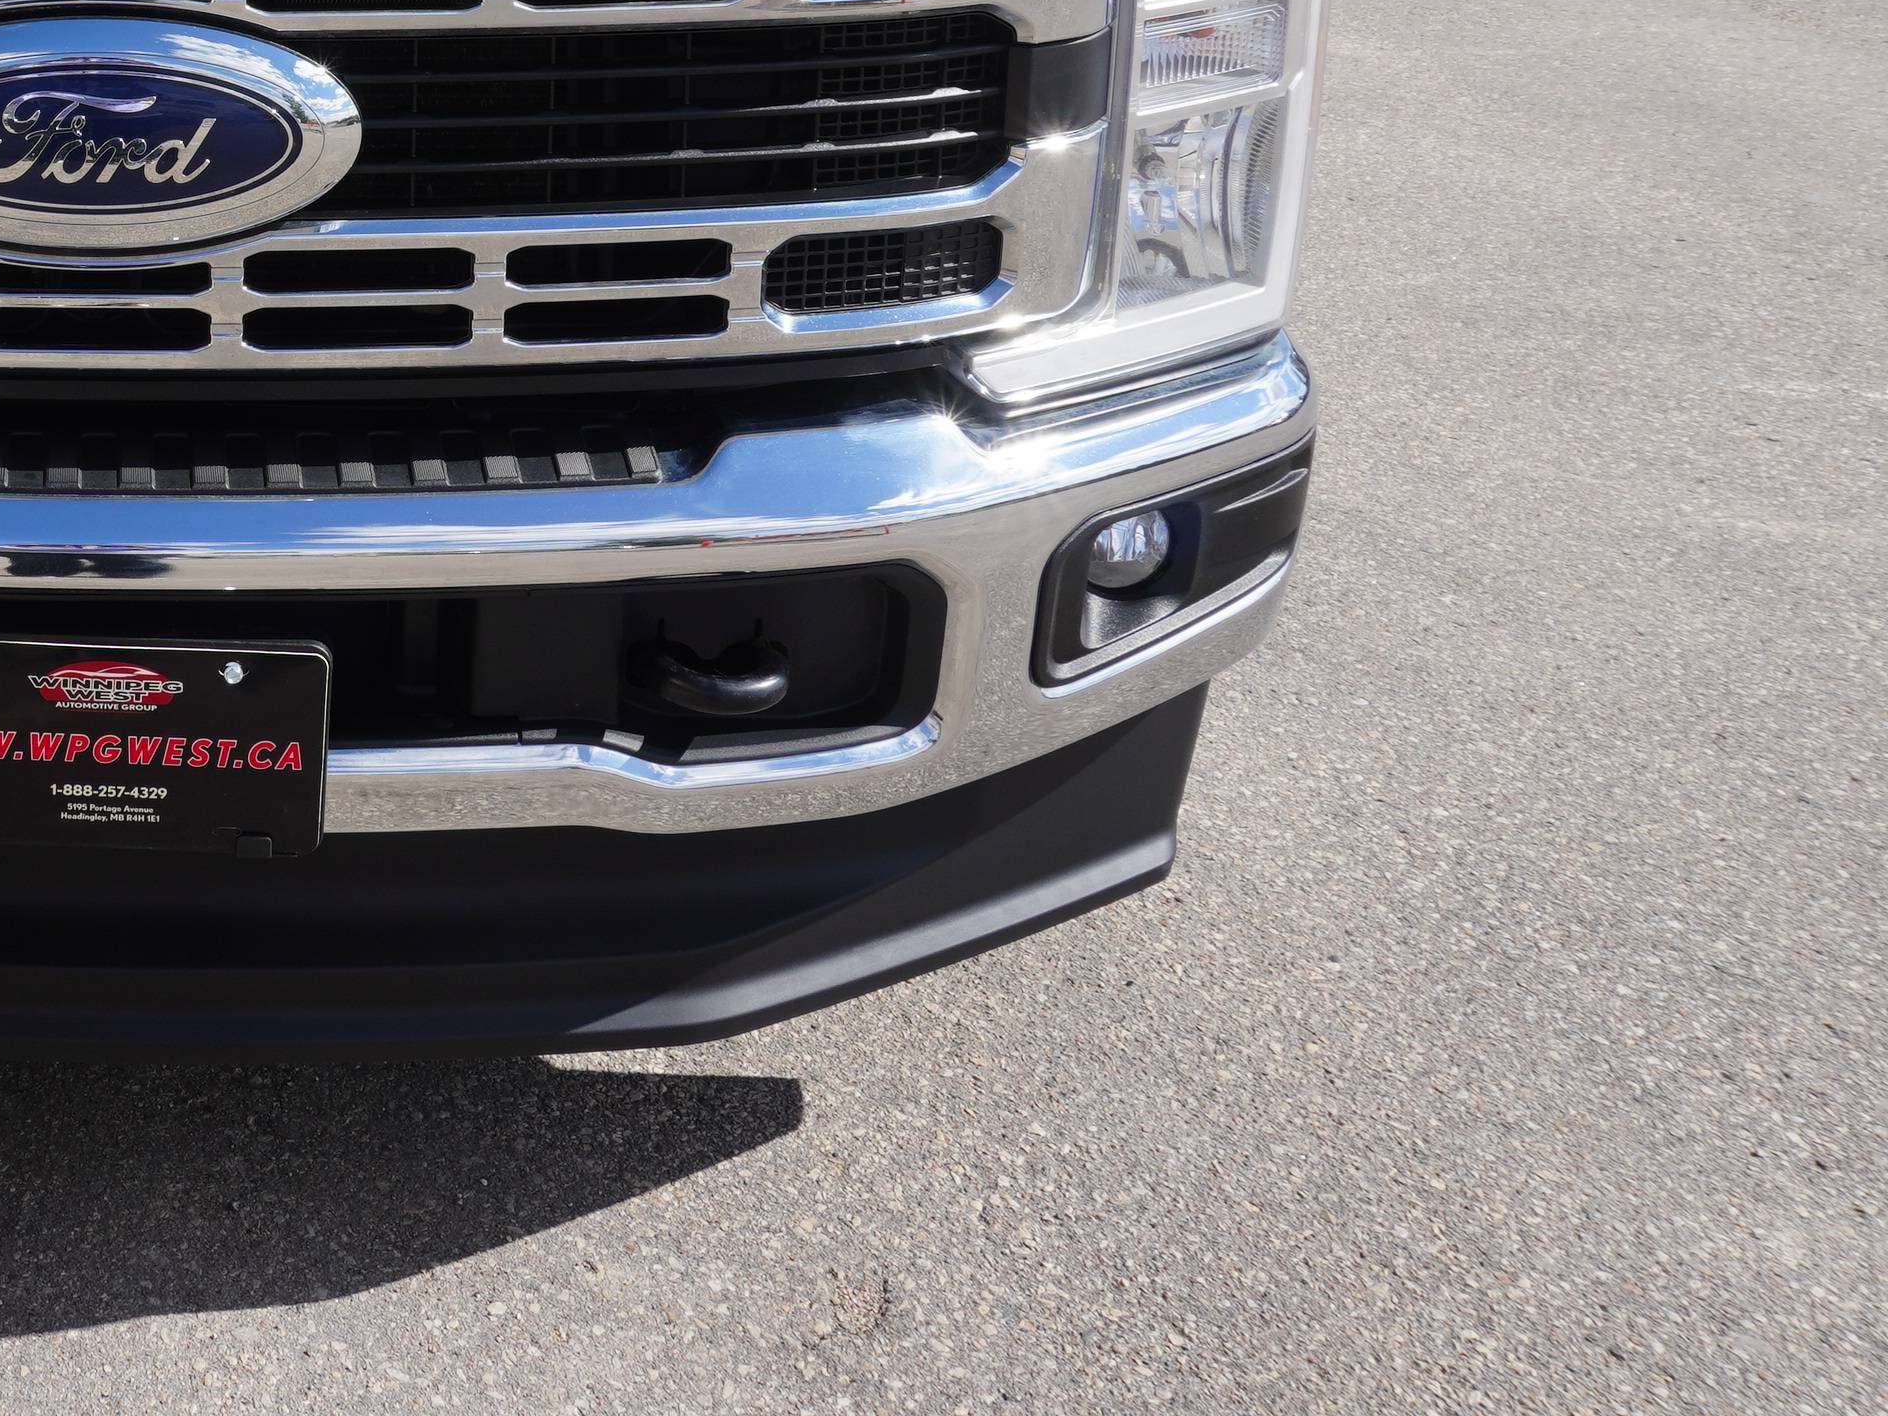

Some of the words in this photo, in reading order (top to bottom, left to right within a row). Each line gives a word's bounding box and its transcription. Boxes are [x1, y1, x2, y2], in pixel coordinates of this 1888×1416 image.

[28, 676, 184, 694] WINNIPEG
[63, 689, 148, 702] WEST
[55, 701, 119, 711] AUTOMOTIVE
[121, 702, 158, 712] GROUP
[50, 783, 168, 800] 1-888-257-4329
[67, 802, 88, 811] 5195
[89, 803, 122, 814] Portage
[123, 805, 154, 813] Avenue
[60, 811, 108, 822] Headingley,
[109, 813, 125, 821] MB
[126, 814, 145, 822] R4H
[146, 815, 161, 823] 1E1
